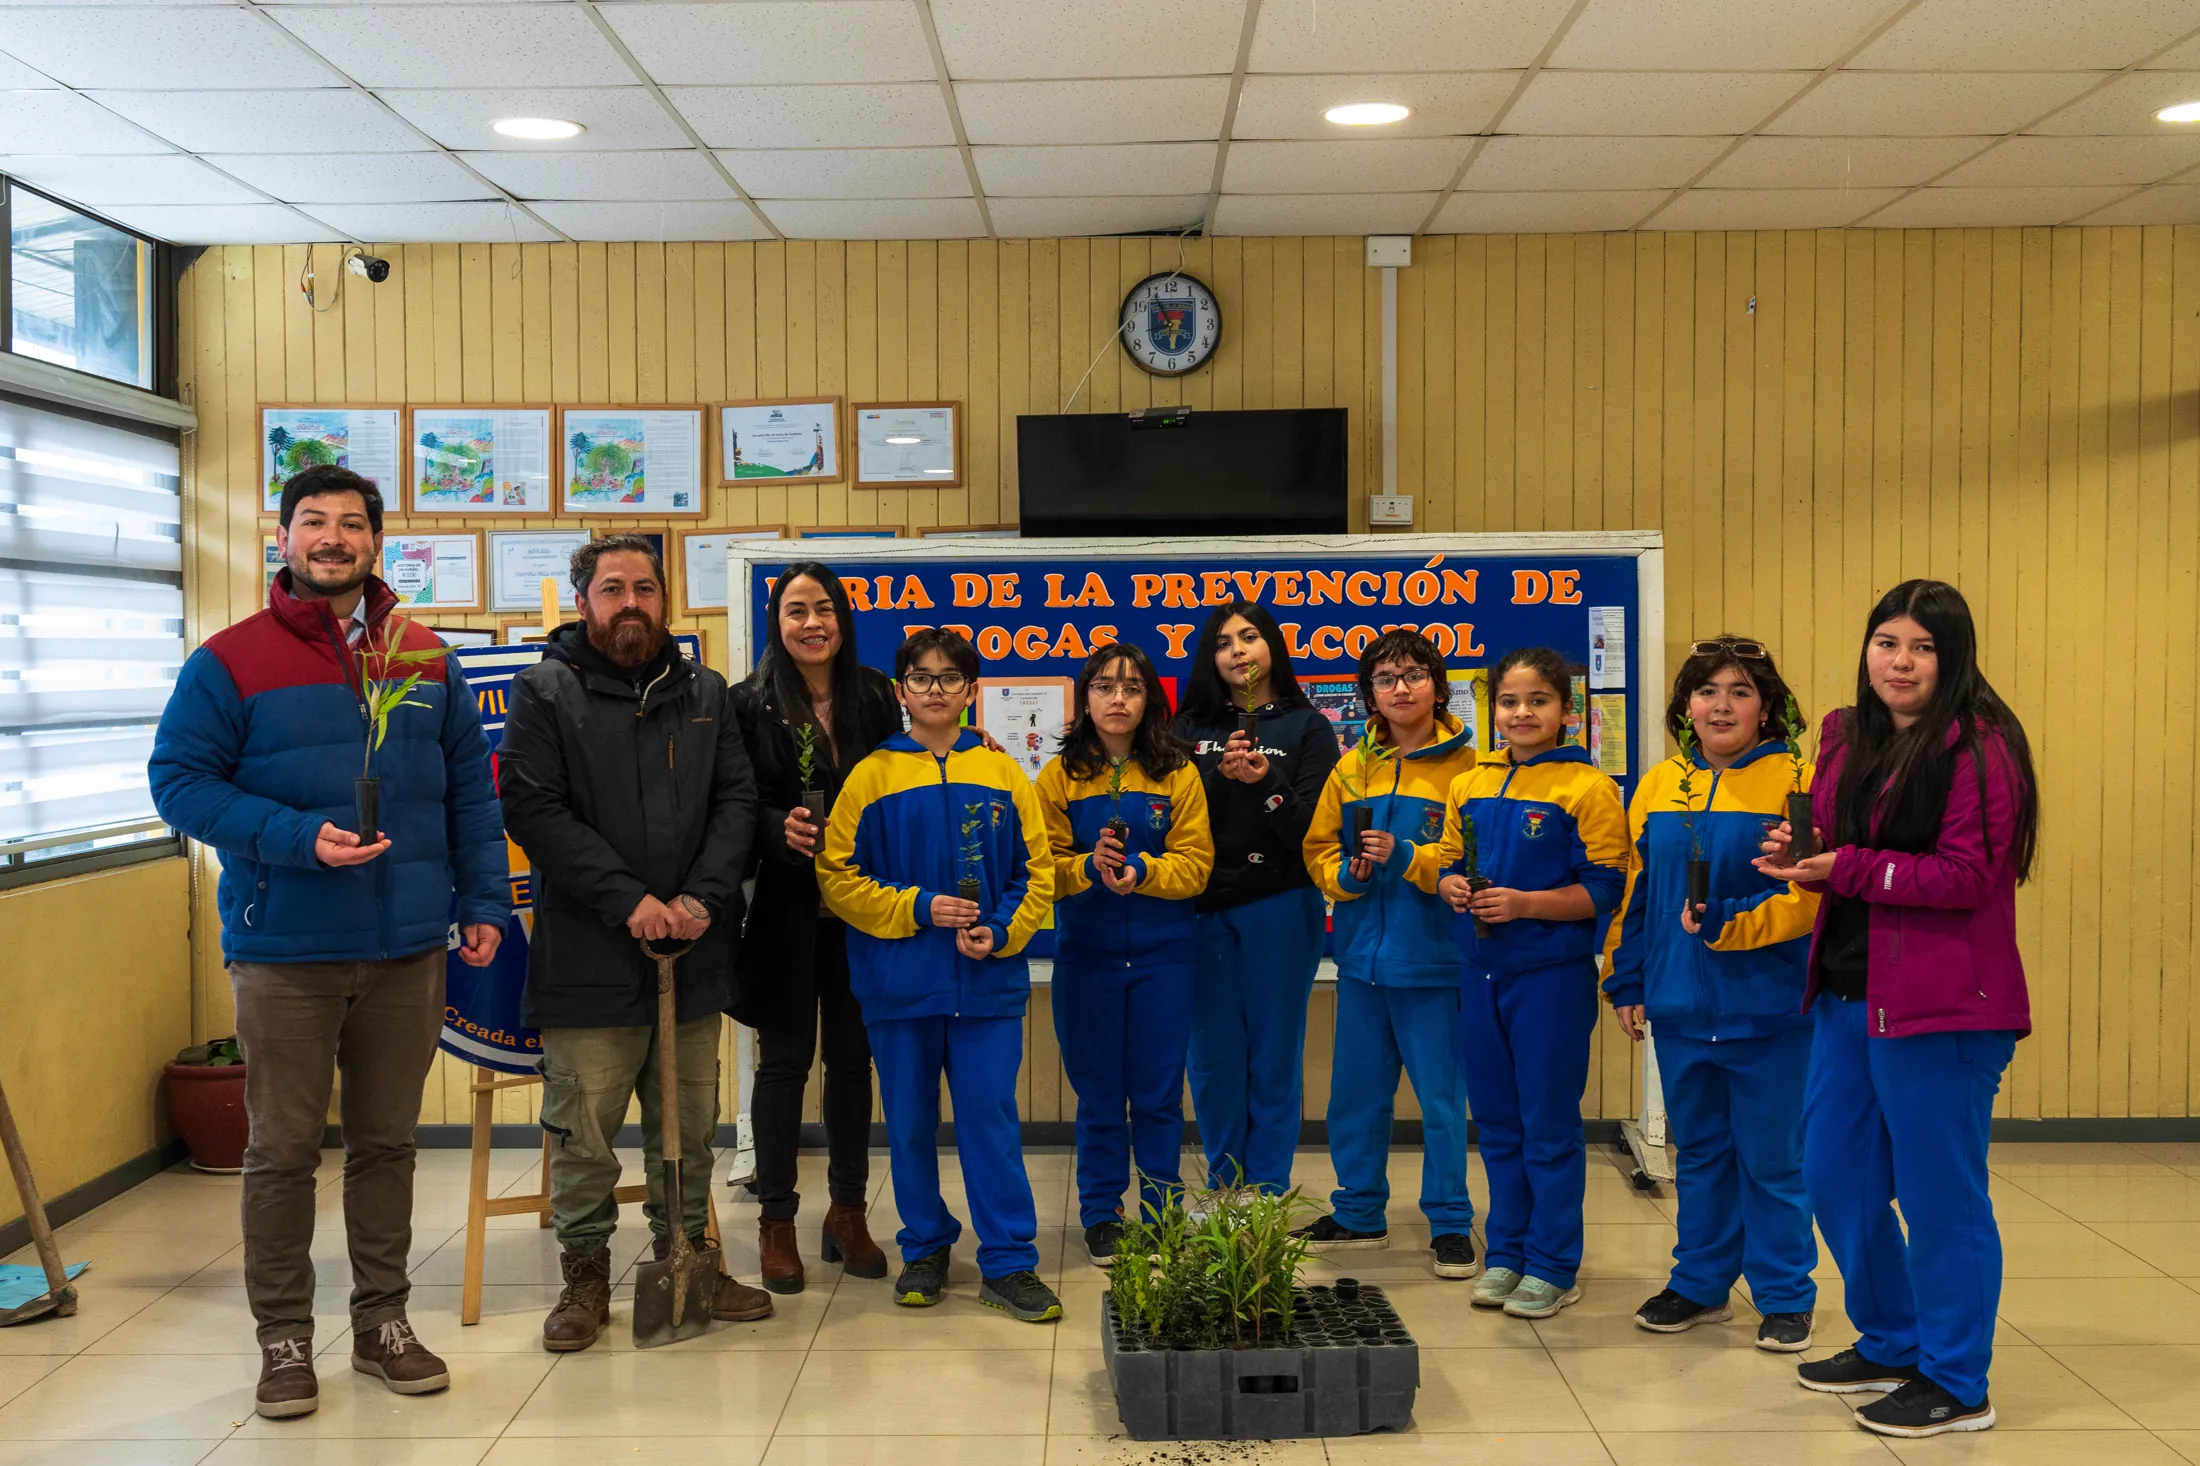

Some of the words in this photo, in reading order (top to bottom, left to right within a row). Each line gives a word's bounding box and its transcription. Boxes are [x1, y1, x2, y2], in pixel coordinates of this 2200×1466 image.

[1164, 281, 1178, 293] 12
[1187, 285, 1193, 297] 1
[1133, 301, 1147, 313] 10
[1200, 299, 1209, 311] 2
[1127, 320, 1136, 333] 9
[1206, 318, 1215, 331] 3
[1133, 338, 1142, 351] 8
[1201, 336, 1210, 348] 4
[1148, 352, 1157, 364] 7
[1187, 351, 1196, 363] 5
[1167, 358, 1176, 370] 6
[951, 572, 1022, 608] DE
[1044, 572, 1115, 608] LA
[1131, 553, 1480, 609] PREVENCIÓN
[1511, 569, 1583, 605] DE
[903, 622, 1119, 660] OGAS
[1156, 624, 1195, 659] Y
[1279, 623, 1485, 660] LCOOL
[1315, 683, 1354, 693] DROGAS
[1194, 740, 1287, 757] Chion
[443, 1006, 516, 1047] Creada
